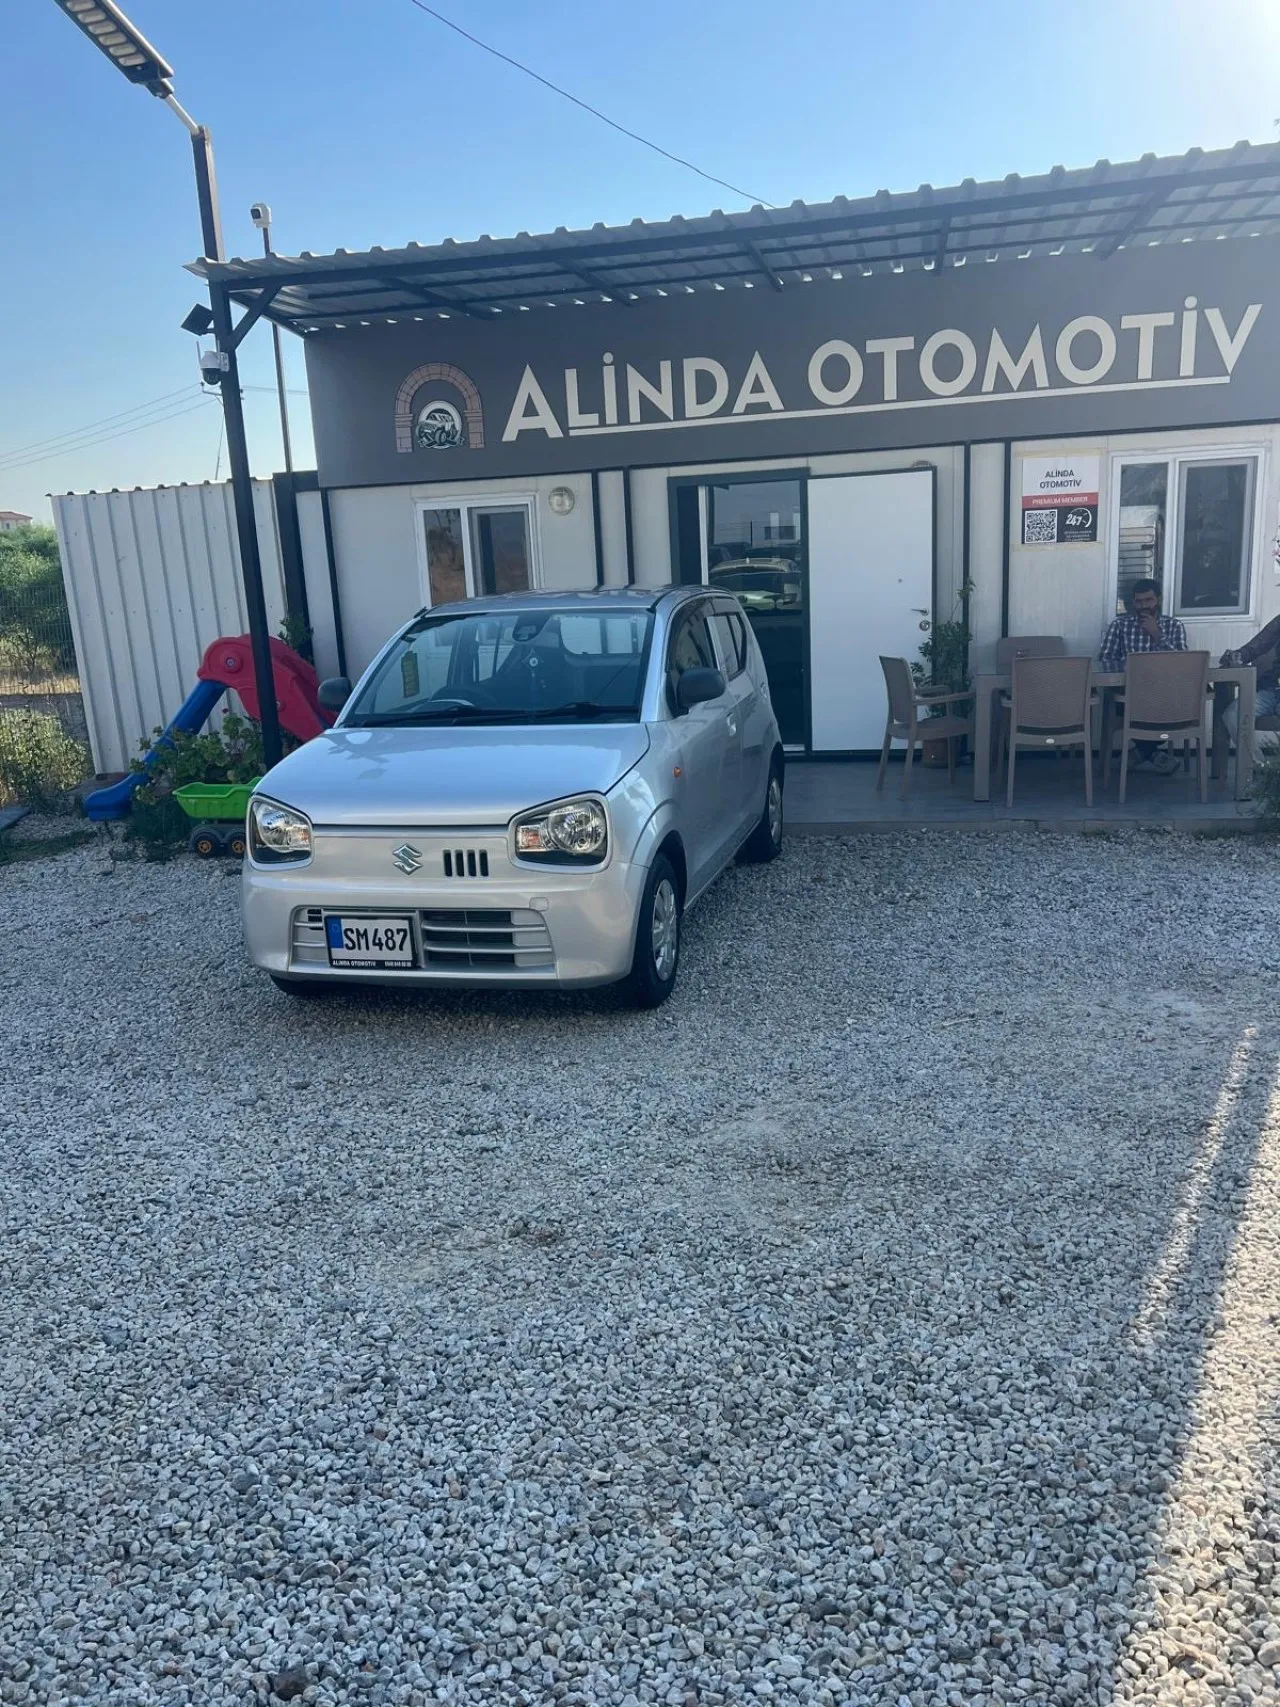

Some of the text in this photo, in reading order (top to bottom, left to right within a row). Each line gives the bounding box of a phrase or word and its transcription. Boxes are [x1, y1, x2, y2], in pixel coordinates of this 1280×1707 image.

[502, 296, 1263, 442] ALİNDA OTOMOTİV
[1045, 469, 1075, 478] ALİNDA
[1040, 479, 1081, 488] OTOMOTİV
[1032, 497, 1061, 505] PREMIUM
